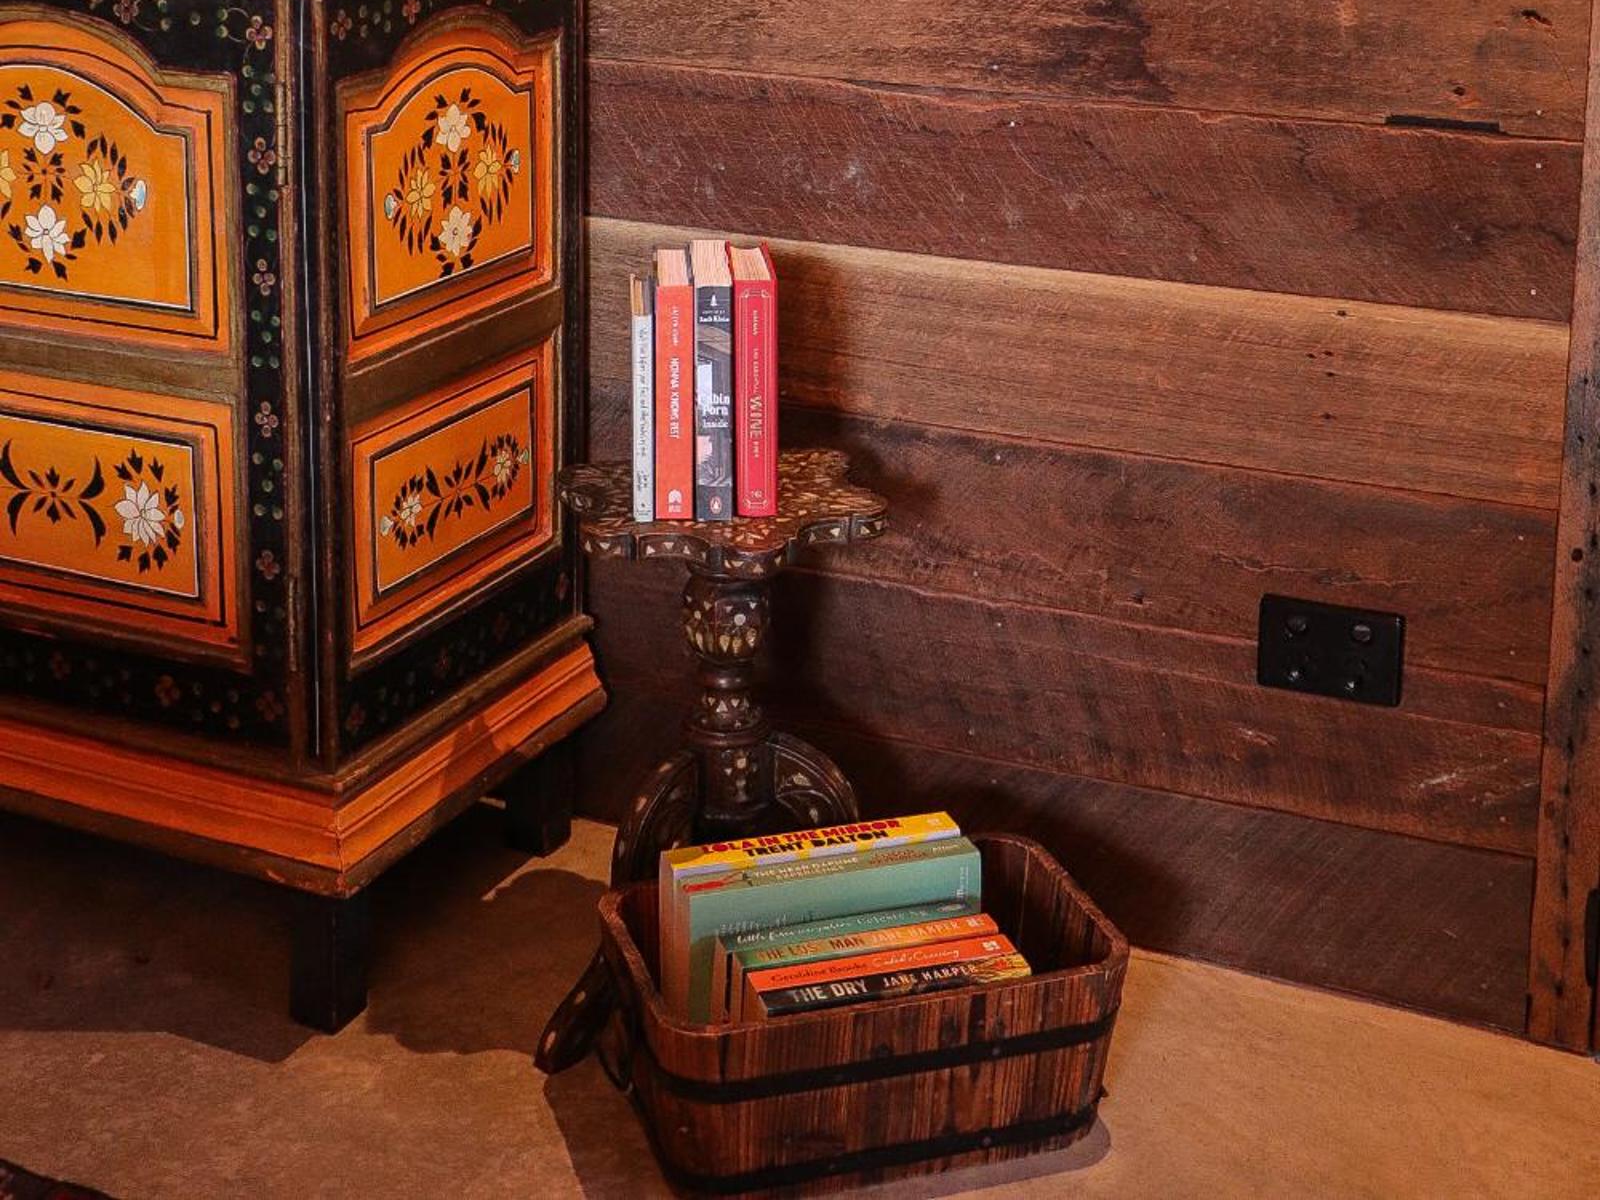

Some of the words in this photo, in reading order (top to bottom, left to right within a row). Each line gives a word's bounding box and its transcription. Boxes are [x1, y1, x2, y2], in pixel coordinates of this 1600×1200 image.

[703, 405, 729, 417] Porn
[749, 395, 763, 440] WINE
[669, 421, 680, 439] BEST
[702, 840, 752, 854] LOLA
[758, 837, 781, 847] IN
[785, 830, 818, 842] THE
[821, 819, 901, 837] MIRROR
[744, 841, 804, 857] TRENT
[811, 830, 889, 848] DALTON
[788, 941, 824, 956] LOS
[829, 936, 865, 950] MAN
[871, 930, 904, 943] JANE
[908, 921, 961, 938] HARPER
[792, 986, 829, 1003] THE
[830, 979, 870, 998] DRY
[882, 974, 919, 988] JANE
[920, 964, 979, 982] HARPER
